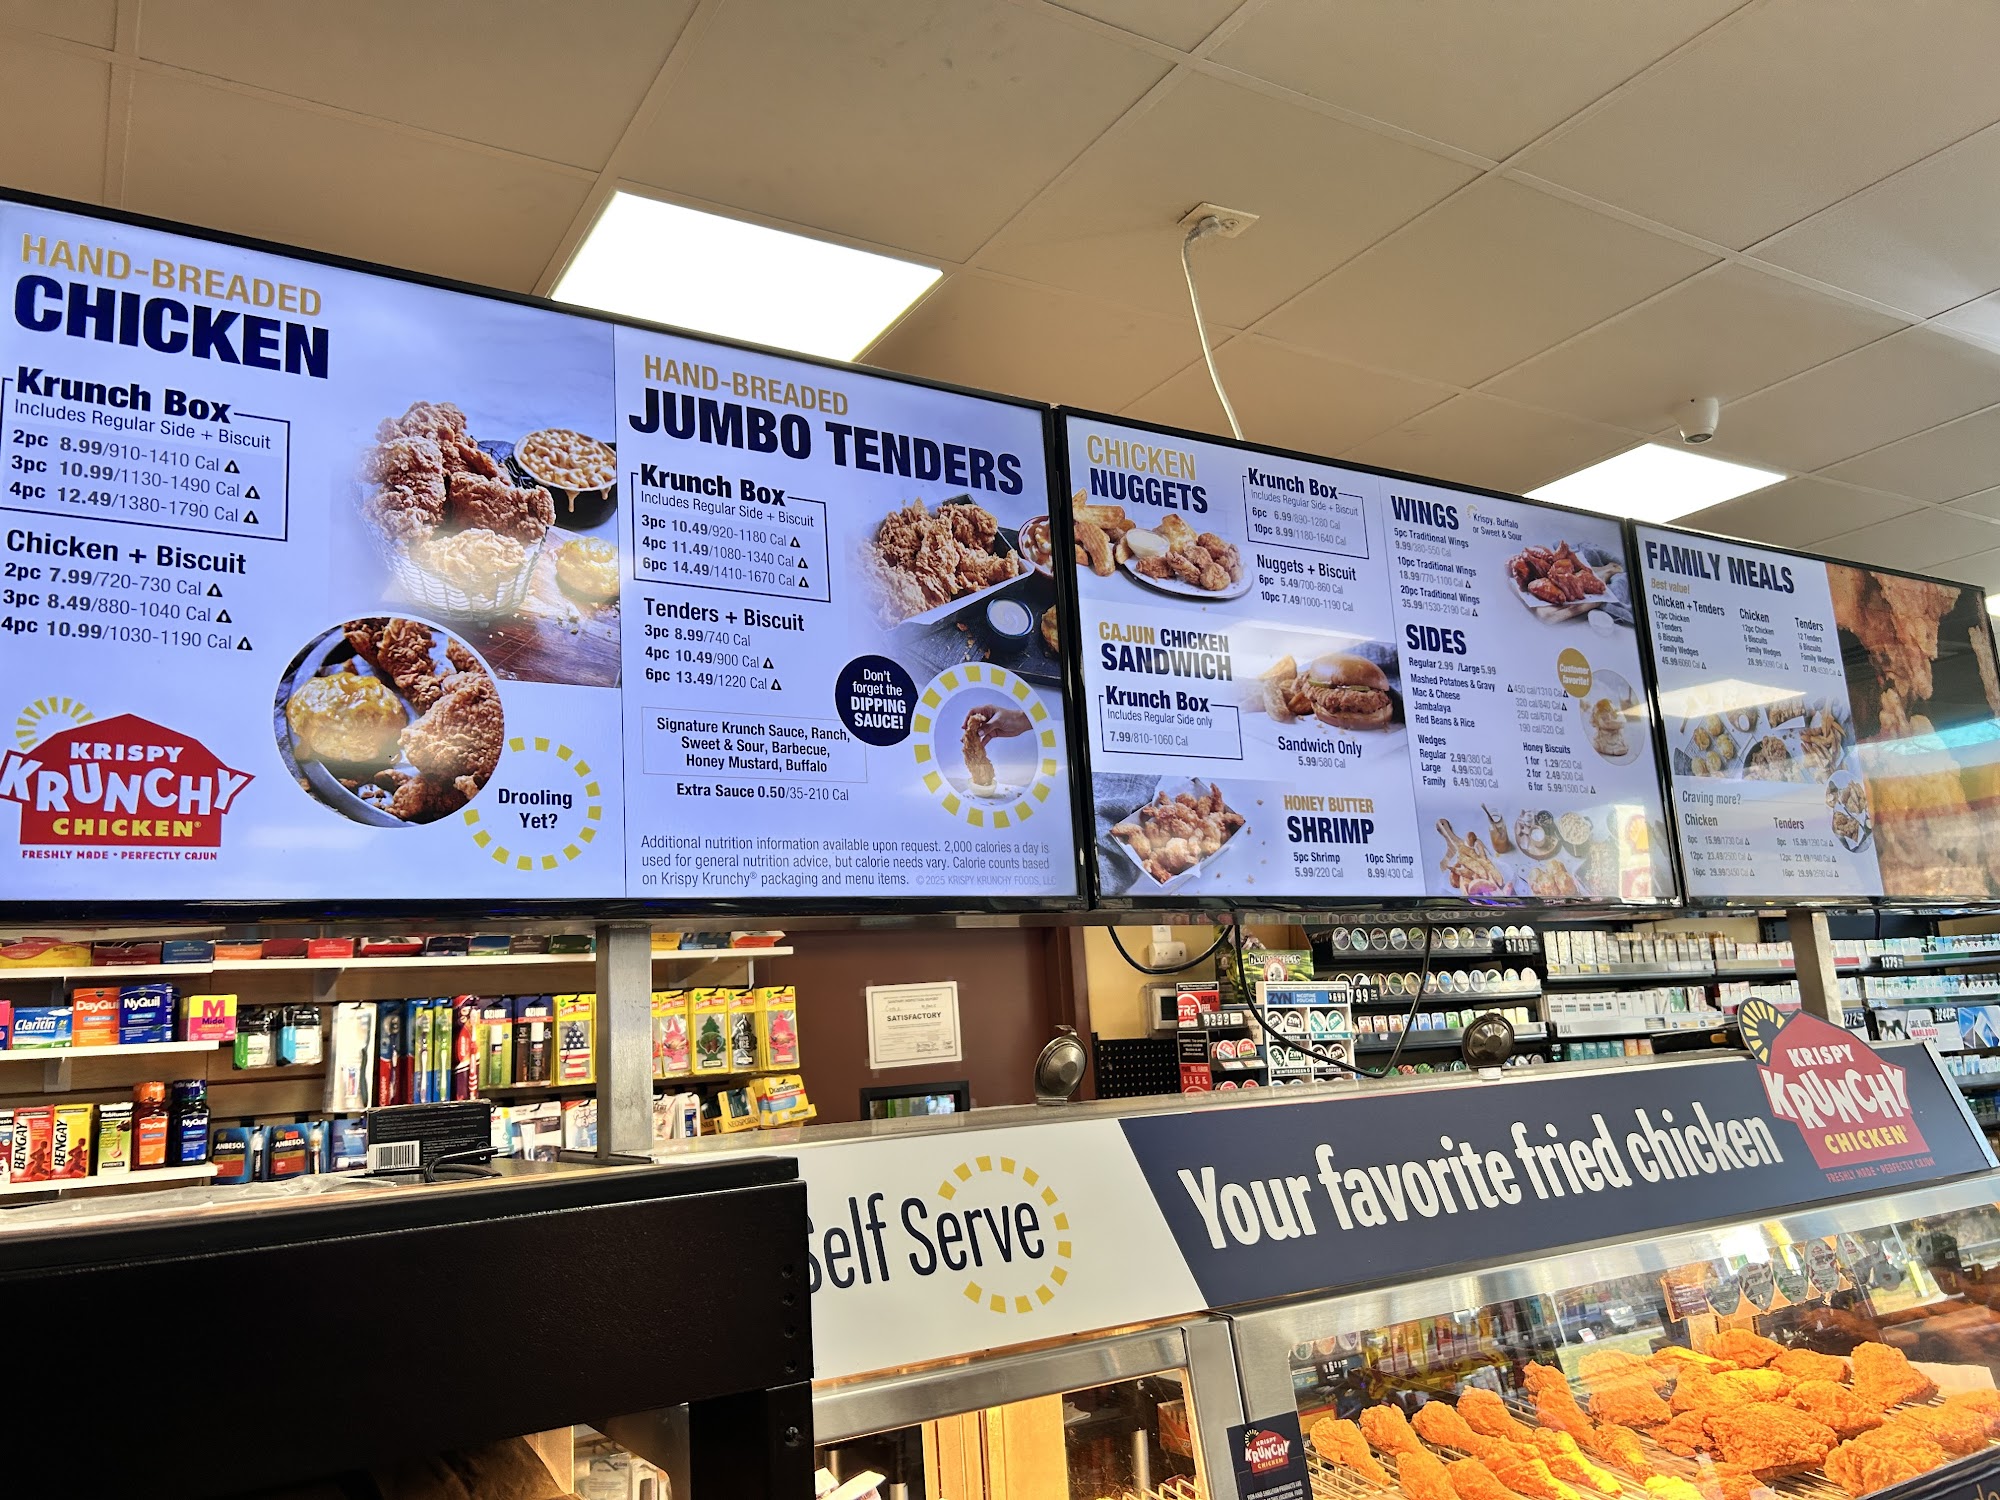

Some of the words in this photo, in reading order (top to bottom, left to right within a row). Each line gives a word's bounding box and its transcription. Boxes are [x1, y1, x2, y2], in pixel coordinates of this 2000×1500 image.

[22, 233, 321, 316] HAND-BREADED
[15, 274, 329, 379] CHICKEN
[17, 366, 151, 412] Krunch
[164, 389, 231, 424] Box
[644, 354, 849, 417] HAND-BREADED
[15, 399, 86, 423] Includes
[92, 411, 155, 434] Regular
[160, 420, 195, 439] Side
[201, 430, 213, 441] +
[219, 429, 271, 450] Biscuit
[13, 429, 48, 449] 2pc
[60, 437, 189, 468] 8.99/910-1410
[195, 456, 219, 472] Cal
[628, 387, 812, 461] JUMBO
[825, 421, 1023, 496] TENDERS
[1087, 434, 1196, 481] CHICKEN
[641, 463, 732, 499] Krunch
[740, 479, 785, 507] Box
[1090, 467, 1209, 514] NUGGETS
[1248, 467, 1305, 494] Krunch
[1309, 478, 1338, 500] Box
[9, 481, 46, 500] 4pc
[57, 487, 209, 519] 12.49/1380-1790
[214, 506, 238, 523] Cal
[1390, 495, 1460, 531] WINGS
[1394, 527, 1408, 539] 5pc
[1409, 529, 1446, 544] Traditional
[1448, 536, 1469, 548] Wings
[7, 529, 118, 562] Chicken
[129, 548, 147, 563] +
[157, 545, 246, 575] Biscuit
[1256, 554, 1304, 576] Nuggets
[1307, 564, 1316, 575] +
[1318, 562, 1357, 582] Biscuit
[1645, 540, 1720, 582] FAMILY
[1727, 556, 1795, 594] MEALS
[4, 562, 41, 581] 2pc
[50, 567, 171, 593] 7.99/720-730
[176, 579, 201, 596] Cal
[1651, 578, 1667, 591] Best
[1668, 582, 1690, 595] value!
[644, 598, 719, 624] Tenders
[725, 612, 737, 623] +
[744, 608, 804, 632] Biscuit
[1652, 594, 1685, 610] Chicken
[1693, 600, 1725, 616] Tenders
[1739, 608, 1770, 623] Chicken
[1795, 617, 1824, 632] Tenders
[1098, 621, 1155, 646] CAJUN
[1160, 628, 1229, 653] CHICKEN
[1406, 623, 1467, 655] SIDES
[1101, 643, 1232, 682] SANDWICH
[1408, 657, 1436, 671] Regular
[1438, 660, 1453, 671] 2.99
[1481, 665, 1496, 675] 5.99
[863, 668, 891, 683] Don't
[1410, 673, 1438, 686] Mashed
[1439, 676, 1468, 688] Potatoes
[1476, 680, 1496, 693] Gravy
[852, 682, 884, 698] forget
[886, 684, 903, 697] the
[1105, 685, 1173, 710] Krunch
[1177, 691, 1209, 713] Box
[1412, 687, 1428, 698] Mac
[1436, 690, 1460, 701] Cheese
[850, 696, 907, 715] DIPPING
[1414, 701, 1452, 713] Jambalaya
[656, 716, 719, 736] Signature
[721, 721, 765, 738] Krunch
[768, 724, 808, 741] Sauce,
[811, 726, 851, 743] Ranch,
[853, 711, 904, 730] SAUCE!
[681, 735, 722, 752] Sweet
[724, 738, 734, 752] &
[735, 739, 768, 756] Sour,
[771, 741, 831, 758] Barbecue,
[1109, 731, 1173, 747] 7.99/810-1060
[1175, 735, 1188, 747] Cal
[1278, 736, 1334, 754] Sandwich
[1337, 740, 1362, 759] Only
[70, 742, 183, 763] KRISPY
[686, 753, 726, 771] Honey
[728, 757, 783, 773] Mustard,
[785, 757, 828, 773] Buffalo
[0, 755, 250, 816] KRUNCHY
[498, 788, 572, 809] Drooling
[1283, 794, 1324, 812] HONEY
[1328, 797, 1374, 814] BUTTER
[1682, 790, 1714, 805] Craving
[1716, 793, 1741, 804] more?
[52, 818, 202, 838] CHICKEN®
[519, 812, 558, 829] Yet?
[1287, 815, 1375, 844] SHRIMP
[22, 850, 72, 860] FRESHLY
[76, 850, 109, 860] MADE
[121, 851, 180, 861] PERFECTLY
[185, 851, 217, 861] CAJUN
[1293, 852, 1309, 865] 5pc
[1310, 851, 1341, 865] Shrimp
[1364, 853, 1384, 865] 10pc
[1385, 853, 1414, 866] Shrimp
[642, 875, 657, 885] on
[661, 872, 698, 887] Krispy
[702, 871, 757, 887] Krunchy®
[761, 873, 818, 887] packaging
[822, 873, 841, 885] and
[845, 873, 875, 886] menu
[877, 873, 909, 886] items.
[76, 1000, 119, 1013] DayQui
[124, 996, 160, 1009] NyQuil
[1267, 992, 1292, 1004] ZYN
[202, 1017, 225, 1025] Midol
[887, 1012, 941, 1022] SATISFACTORY
[1178, 1004, 1196, 1017] FRE
[15, 1019, 55, 1031] Claritin
[1787, 1044, 1854, 1067] KRISPY
[1761, 1064, 1909, 1129] KRUNCHY
[727, 1116, 760, 1128] NEOSPORIN
[14, 1122, 27, 1170] BENGAY
[54, 1119, 68, 1167] BENGAY
[216, 1142, 245, 1150] ANBESOL
[275, 1138, 305, 1148] ANBESOL
[1177, 1166, 1318, 1250] Your
[1314, 1136, 1521, 1231] favorite
[1513, 1114, 1633, 1200] fried
[1626, 1101, 1784, 1184] chicken
[1826, 1169, 1855, 1183] FRESHLY
[1856, 1166, 1877, 1179] MADE
[1880, 1160, 1915, 1174] PERFECTLY
[1915, 1157, 1936, 1169] CAJUN
[901, 1197, 1044, 1276] Serve
[1245, 1440, 1291, 1464] KRUNCHY
[1256, 1436, 1276, 1447] KRISPY
[1257, 1458, 1284, 1469] CHICKEN
